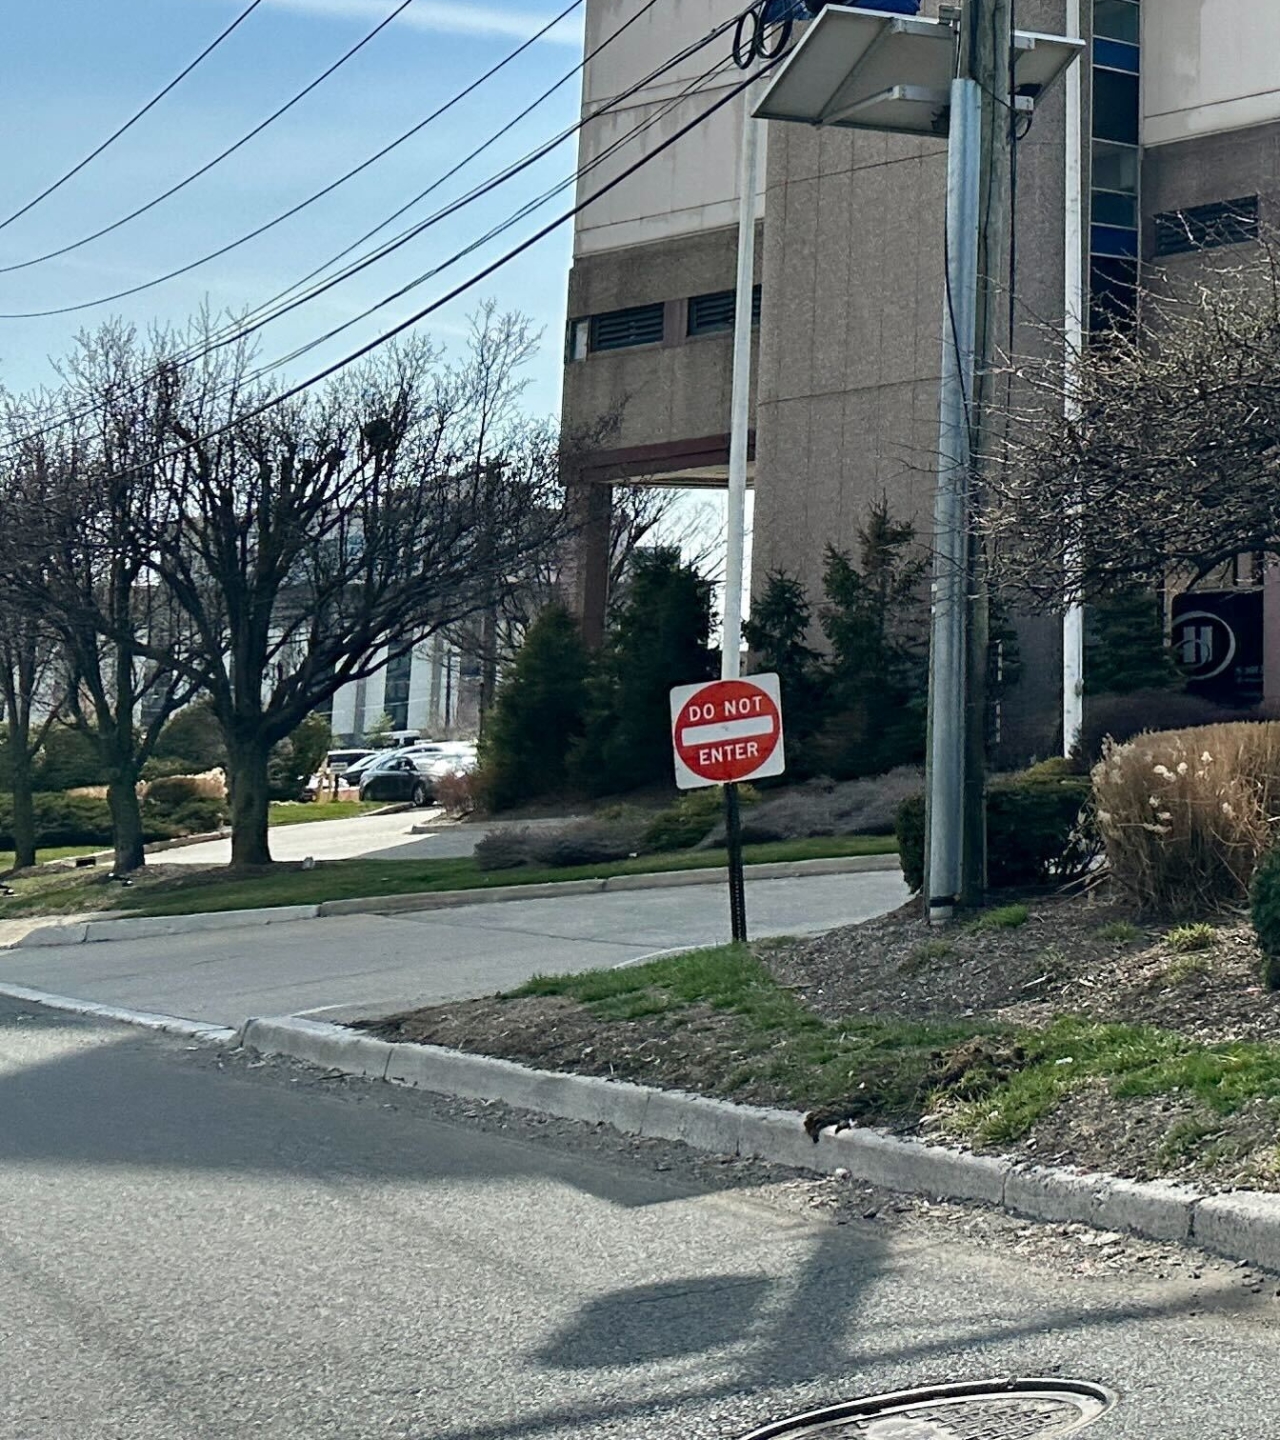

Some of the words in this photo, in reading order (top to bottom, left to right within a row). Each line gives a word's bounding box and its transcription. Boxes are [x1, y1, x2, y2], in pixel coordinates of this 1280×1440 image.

[688, 703, 715, 722] DO
[724, 696, 763, 716] NOT
[699, 741, 758, 766] ENTER
